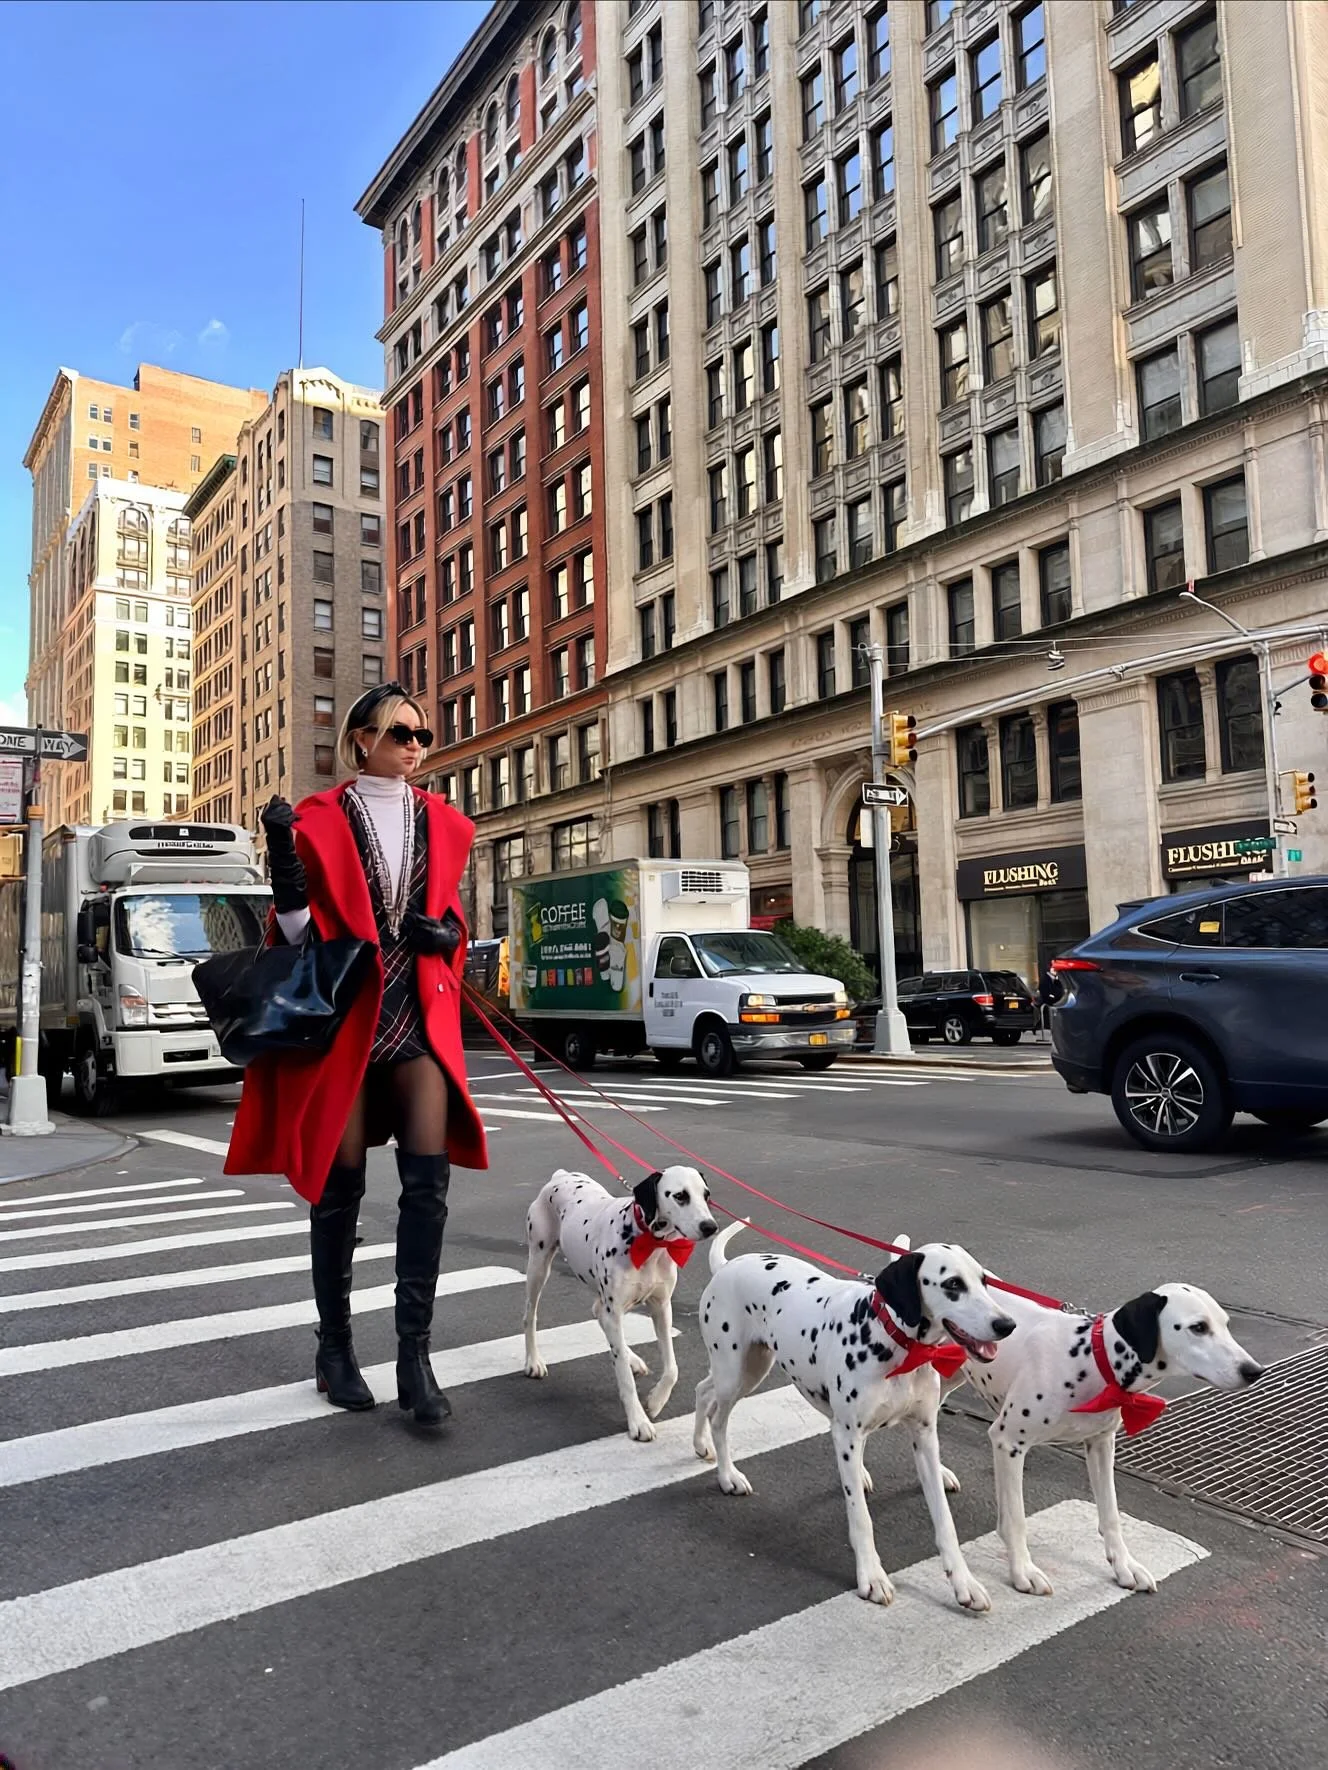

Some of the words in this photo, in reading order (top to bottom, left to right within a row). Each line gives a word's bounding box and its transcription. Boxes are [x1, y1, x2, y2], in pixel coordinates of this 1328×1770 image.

[44, 738, 75, 753] WAY
[983, 861, 1059, 885] FLUSHING
[540, 902, 586, 924] COFFEE
